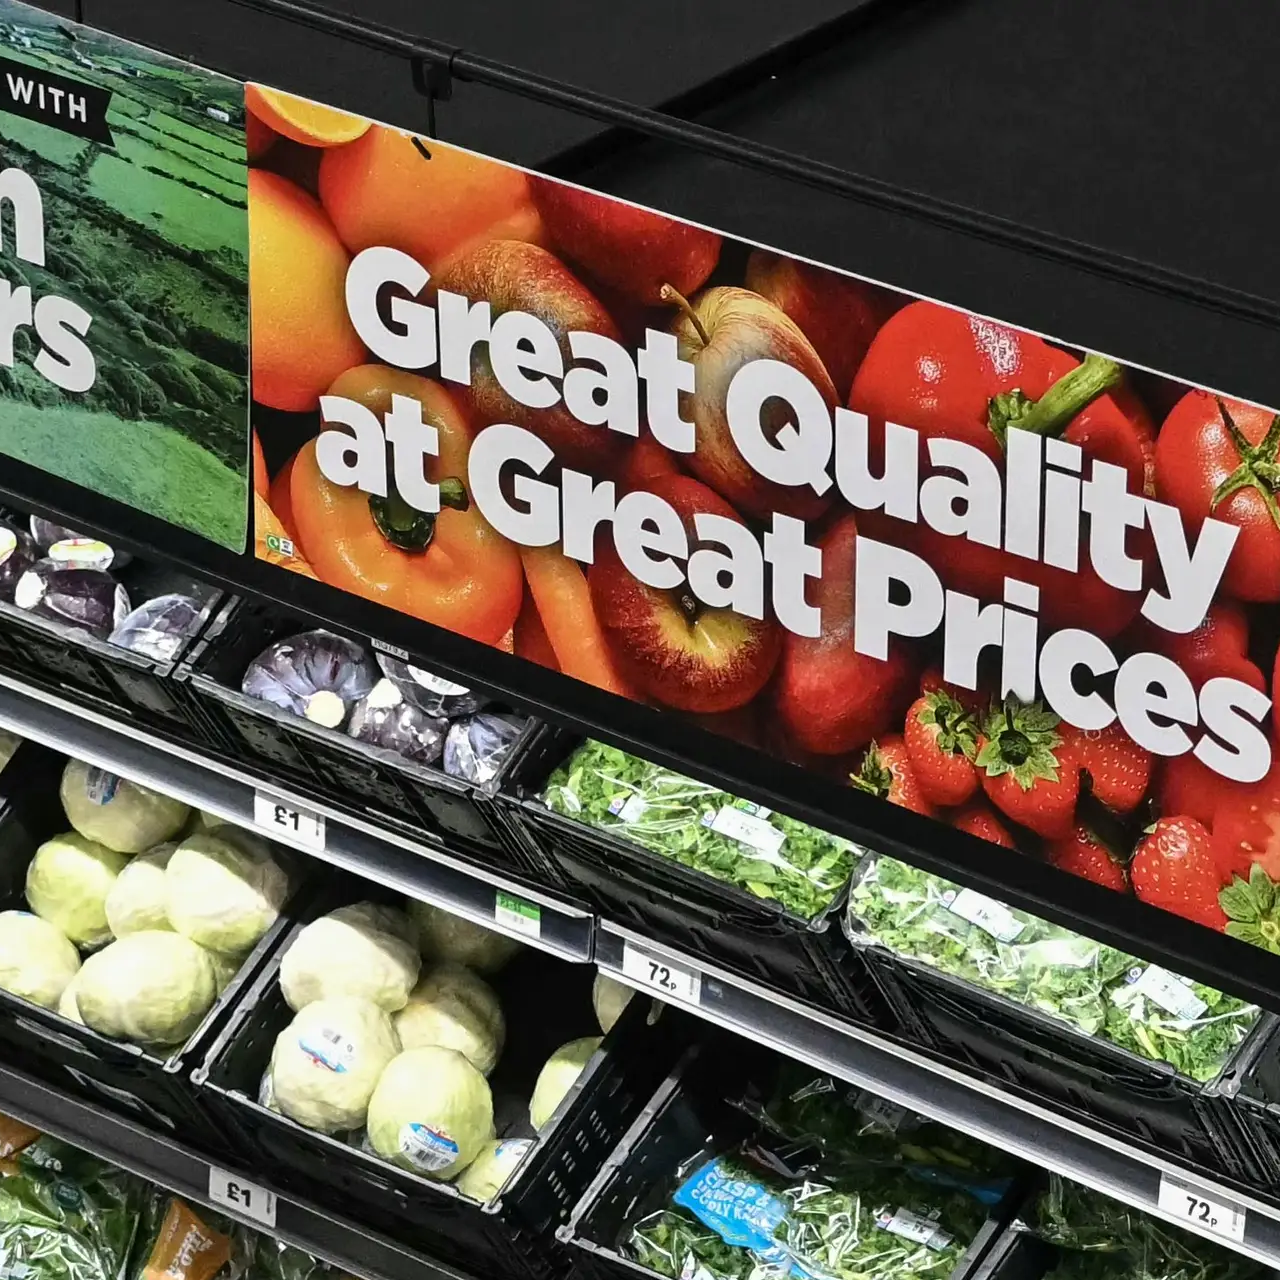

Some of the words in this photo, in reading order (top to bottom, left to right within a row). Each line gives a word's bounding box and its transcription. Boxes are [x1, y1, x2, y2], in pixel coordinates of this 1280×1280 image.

[6, 73, 88, 123] WITH
[345, 245, 696, 453] Great
[726, 358, 1240, 634] Quality
[315, 392, 441, 513] at
[467, 423, 822, 639] Great
[854, 535, 1272, 783] Prices
[274, 805, 300, 831] £1
[649, 962, 677, 991] 72p
[227, 1182, 251, 1207] £1
[1186, 1196, 1218, 1228] 72p
